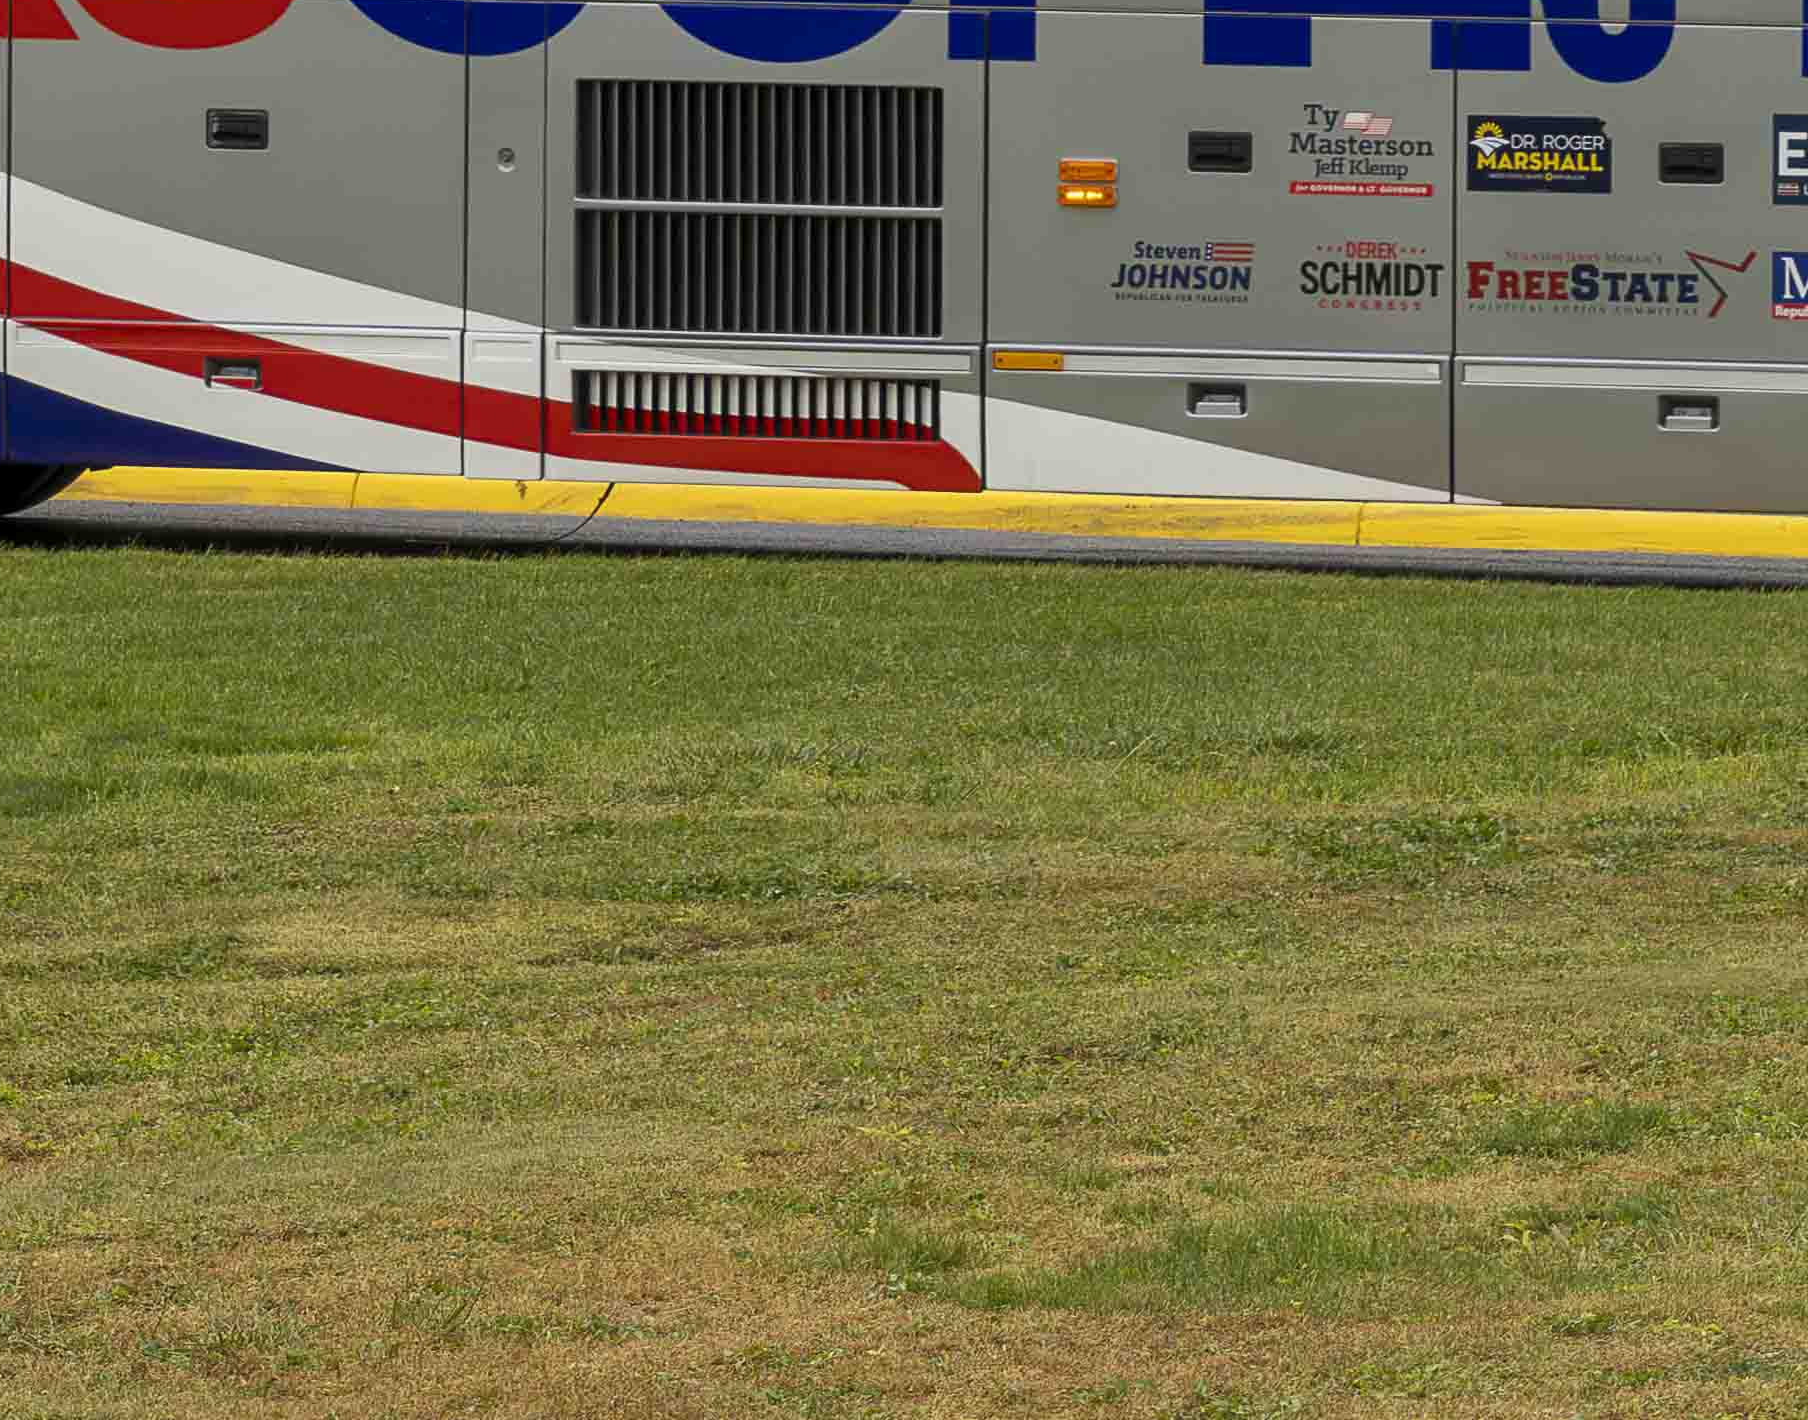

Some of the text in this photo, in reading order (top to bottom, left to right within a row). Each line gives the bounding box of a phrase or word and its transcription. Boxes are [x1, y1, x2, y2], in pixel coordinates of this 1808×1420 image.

[1303, 103, 1340, 132] Ty
[1288, 131, 1435, 157] Masterson
[1542, 134, 1606, 151] ROGER
[1313, 157, 1409, 181] Jeff Klemp
[1475, 151, 1605, 173] MARSHALL
[1134, 241, 1201, 260] Steven
[1345, 241, 1398, 260] DEREK
[1110, 263, 1252, 291] JOHNSON
[1300, 260, 1445, 297] SCHMIDT
